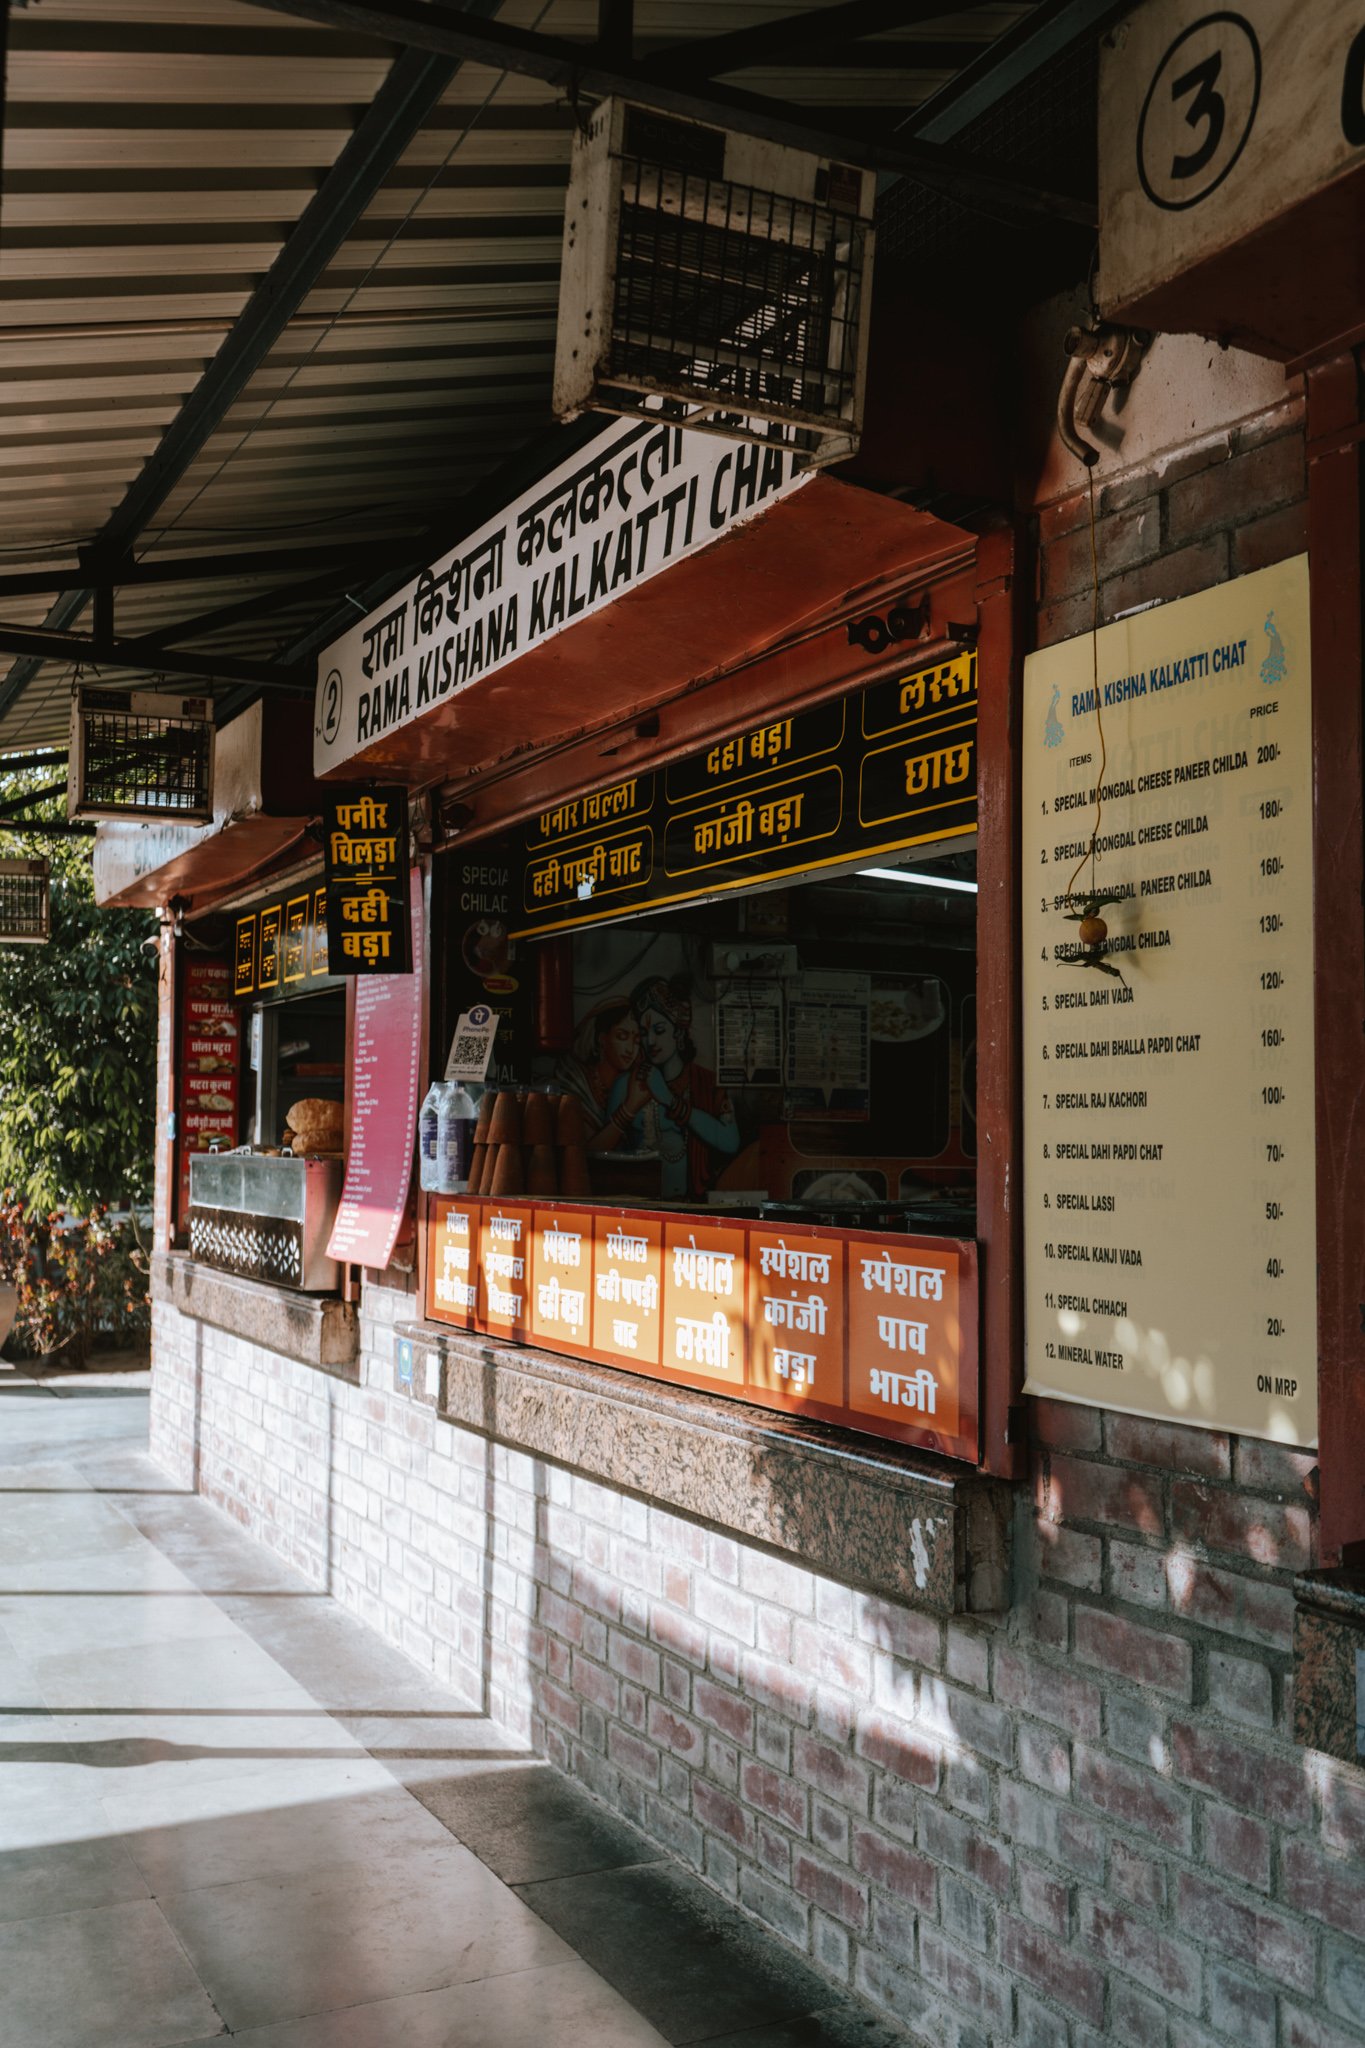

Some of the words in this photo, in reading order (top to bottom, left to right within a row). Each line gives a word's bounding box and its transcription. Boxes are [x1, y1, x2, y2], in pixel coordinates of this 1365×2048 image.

[1171, 50, 1225, 179] 3
[357, 666, 410, 744] RAMA
[416, 593, 518, 708] KISHANA
[528, 474, 699, 641] KALKATTI
[361, 600, 408, 680] रामा
[413, 524, 507, 646] किशना
[1072, 687, 1102, 717] RAMA
[1104, 672, 1147, 707] KISHNA
[1150, 652, 1209, 692] KALKATTI
[1212, 639, 1247, 673] CHAT
[326, 680, 337, 730] 2
[1250, 701, 1279, 719] PRICE
[905, 740, 974, 795] छाछ
[1041, 800, 1048, 815] 1.
[1055, 791, 1087, 812] SPECIAL
[1089, 779, 1135, 804] MOONGDAL
[1137, 769, 1172, 793] CHEESE
[1174, 760, 1210, 784] PANEER
[1213, 751, 1248, 775] CHILDA
[1257, 742, 1281, 764] 200/-
[1069, 753, 1092, 768] ITEMS
[336, 796, 388, 830] पनीर
[694, 800, 755, 854] कांजी
[759, 793, 804, 843] बड़ा
[1041, 848, 1048, 864] 2.
[1054, 841, 1087, 862] SPECIAL
[1089, 831, 1136, 854] MOONGDAL
[1138, 822, 1172, 845] CHEESE
[1174, 815, 1209, 837] CHILDA
[1259, 799, 1283, 820] 180/-
[331, 832, 397, 871] चिलड़ा
[533, 859, 560, 897] दही
[609, 842, 643, 876] चाट
[340, 888, 390, 923] दही
[1041, 898, 1048, 913] 3.
[1140, 875, 1175, 897] PANEER
[1177, 869, 1212, 891] CHILDA
[1260, 856, 1284, 876] 160/-
[341, 931, 392, 965] बड़ा
[1041, 946, 1048, 961] 4.
[1138, 930, 1171, 949] CHILDA
[1260, 914, 1283, 933] 130/-
[1042, 996, 1049, 1011] 5.
[1055, 992, 1088, 1010] SPECIAL
[1090, 989, 1109, 1006] DAHI
[1111, 987, 1134, 1005] VADA
[1261, 971, 1284, 991] 120/-
[1042, 1045, 1049, 1060] 6.
[1055, 1043, 1088, 1059] SPECIAL
[1090, 1041, 1109, 1057] DAHI
[1112, 1038, 1145, 1056] BHALLA
[1148, 1036, 1173, 1053] PAPDI
[1176, 1035, 1201, 1052] CHAT
[1261, 1029, 1285, 1047] 160/-
[1043, 1094, 1050, 1109] 7.
[1056, 1093, 1089, 1109] SPECIAL
[1091, 1092, 1107, 1109] RAJ
[1109, 1091, 1147, 1108] KACHORI
[1262, 1086, 1285, 1104] 100/-
[1043, 1144, 1050, 1159] 8.
[1056, 1144, 1089, 1159] SPECIAL
[1091, 1144, 1111, 1159] DAHI
[1113, 1144, 1137, 1160] PAPDI
[1140, 1144, 1163, 1160] CHAT
[1266, 1144, 1284, 1162] 70/-
[490, 1210, 522, 1242] स्पेशल
[1044, 1193, 1050, 1208] 9.
[1056, 1194, 1089, 1210] SPECIAL
[1091, 1195, 1115, 1212] LASSI
[1266, 1202, 1284, 1220] 50/-
[543, 1220, 582, 1267] स्पेशल
[606, 1225, 649, 1263] स्पेशल
[673, 1234, 735, 1295] स्पेशल
[759, 1239, 832, 1284] स्पेशल
[1044, 1243, 1055, 1258] 10.
[1057, 1244, 1090, 1261] SPECIAL
[1092, 1247, 1117, 1264] KANJI
[1119, 1249, 1143, 1266] VADA
[1266, 1258, 1284, 1278] 40/-
[538, 1276, 560, 1321] दही
[596, 1268, 621, 1302] दही
[622, 1274, 658, 1317] पपड़ी
[860, 1251, 946, 1302] स्पेशल
[612, 1319, 638, 1350] चाट
[763, 1290, 828, 1336] कांजी
[877, 1315, 929, 1356] पाव
[1045, 1293, 1056, 1308] 11.
[1058, 1294, 1090, 1313] SPECIAL
[1093, 1298, 1127, 1317] CHHACH
[1267, 1318, 1285, 1336] 20/-
[675, 1311, 730, 1369] लस्सी
[773, 1347, 817, 1392] बड़ा
[869, 1367, 939, 1415] भाजी
[1046, 1343, 1056, 1358] 12.
[1058, 1345, 1093, 1365] MINERAL
[1095, 1350, 1124, 1370] WATER
[1257, 1374, 1272, 1394] ON
[1275, 1377, 1298, 1397] MRP
